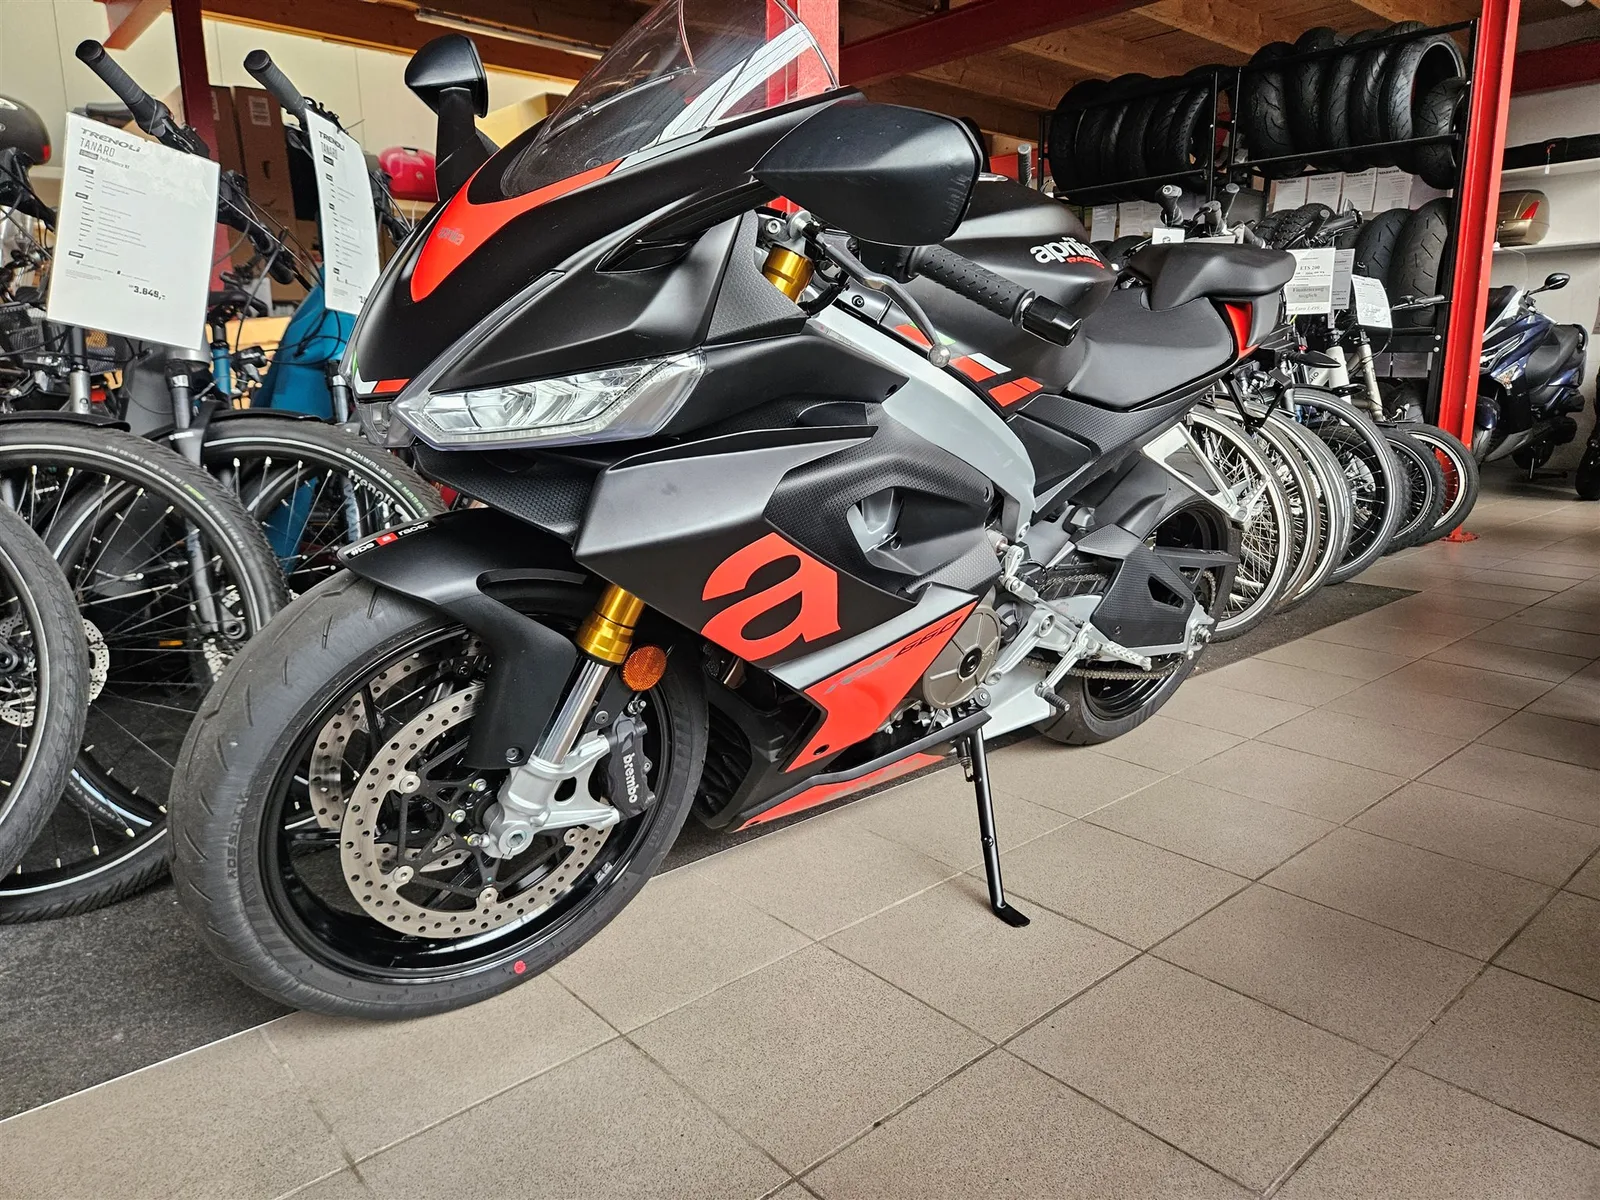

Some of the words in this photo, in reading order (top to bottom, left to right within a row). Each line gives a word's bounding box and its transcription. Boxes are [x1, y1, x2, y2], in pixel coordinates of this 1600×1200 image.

[1030, 236, 1101, 264] aprilia
[345, 447, 393, 480] SCHWALBE
[397, 522, 430, 536] racer
[622, 752, 640, 804] brembo
